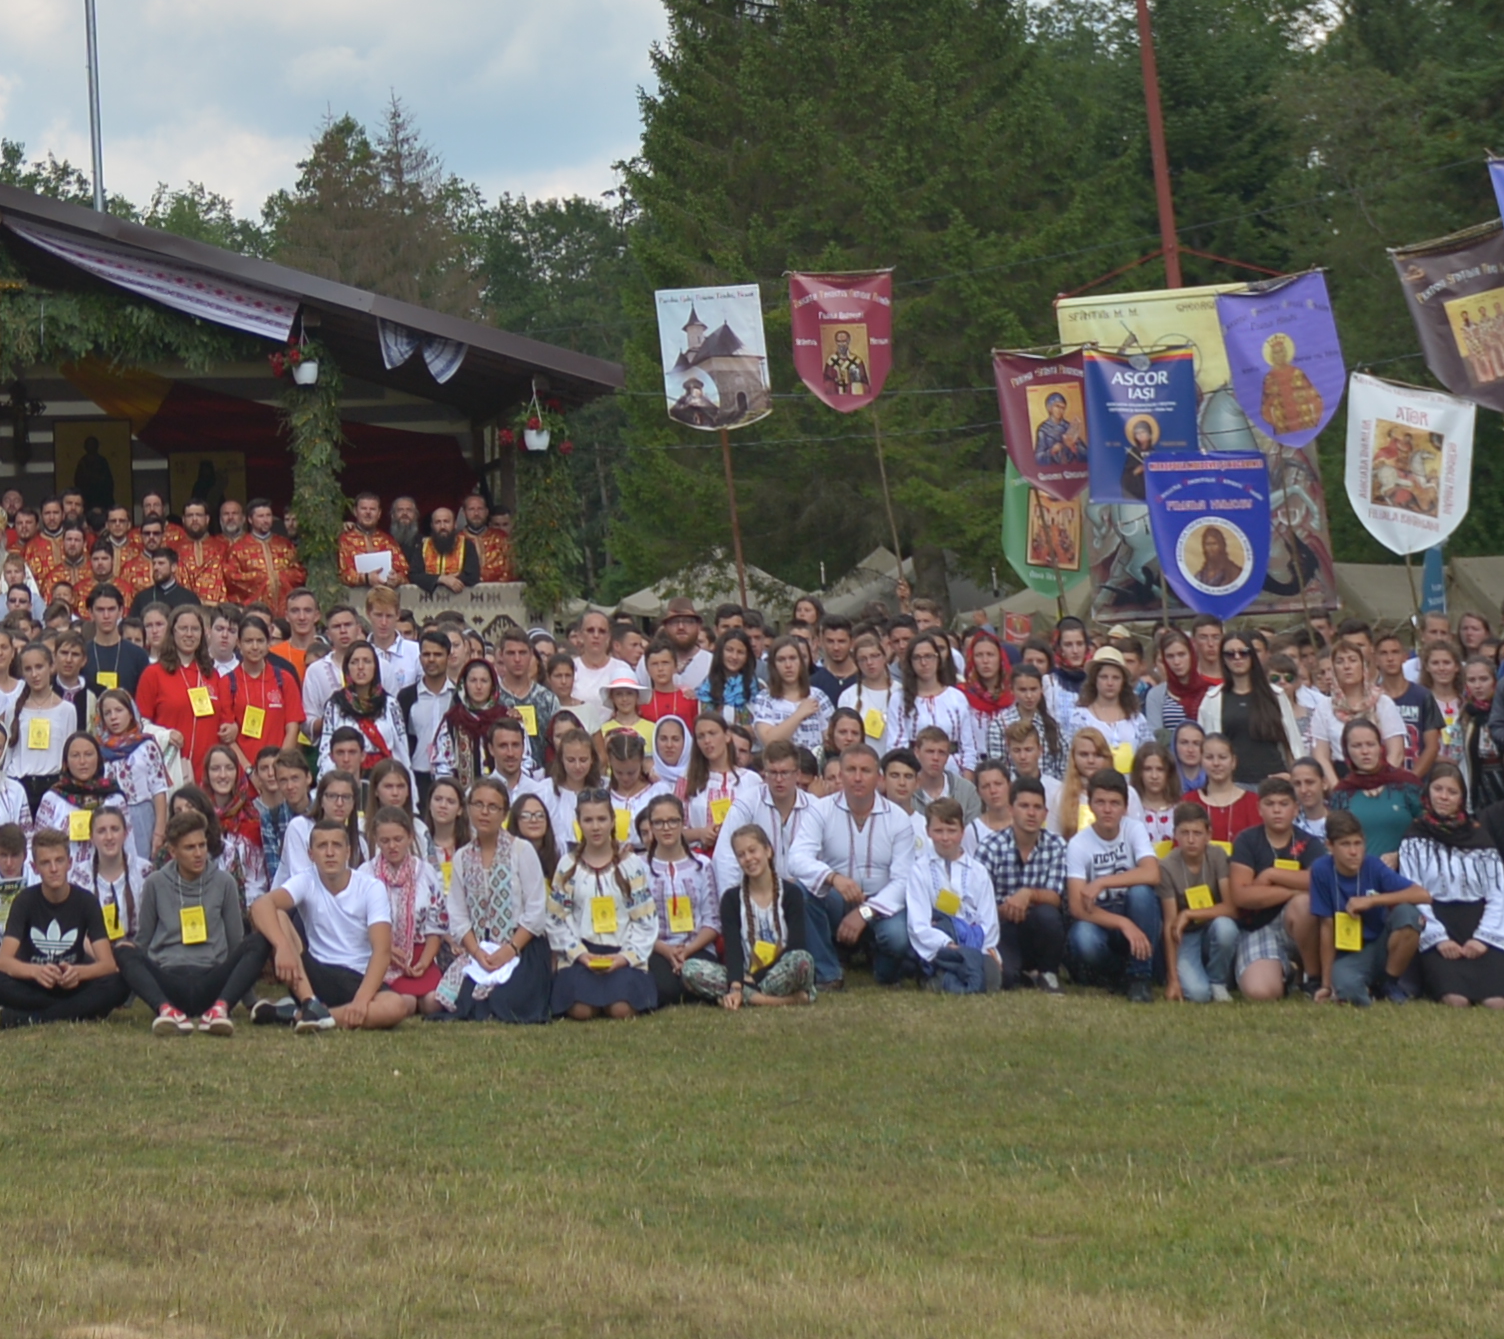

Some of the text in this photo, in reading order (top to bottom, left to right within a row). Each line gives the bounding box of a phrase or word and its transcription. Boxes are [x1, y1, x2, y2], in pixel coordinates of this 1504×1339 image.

[1111, 371, 1169, 385] ASCOR
[1128, 388, 1155, 401] IAȘI
[1396, 407, 1428, 426] ATOR
